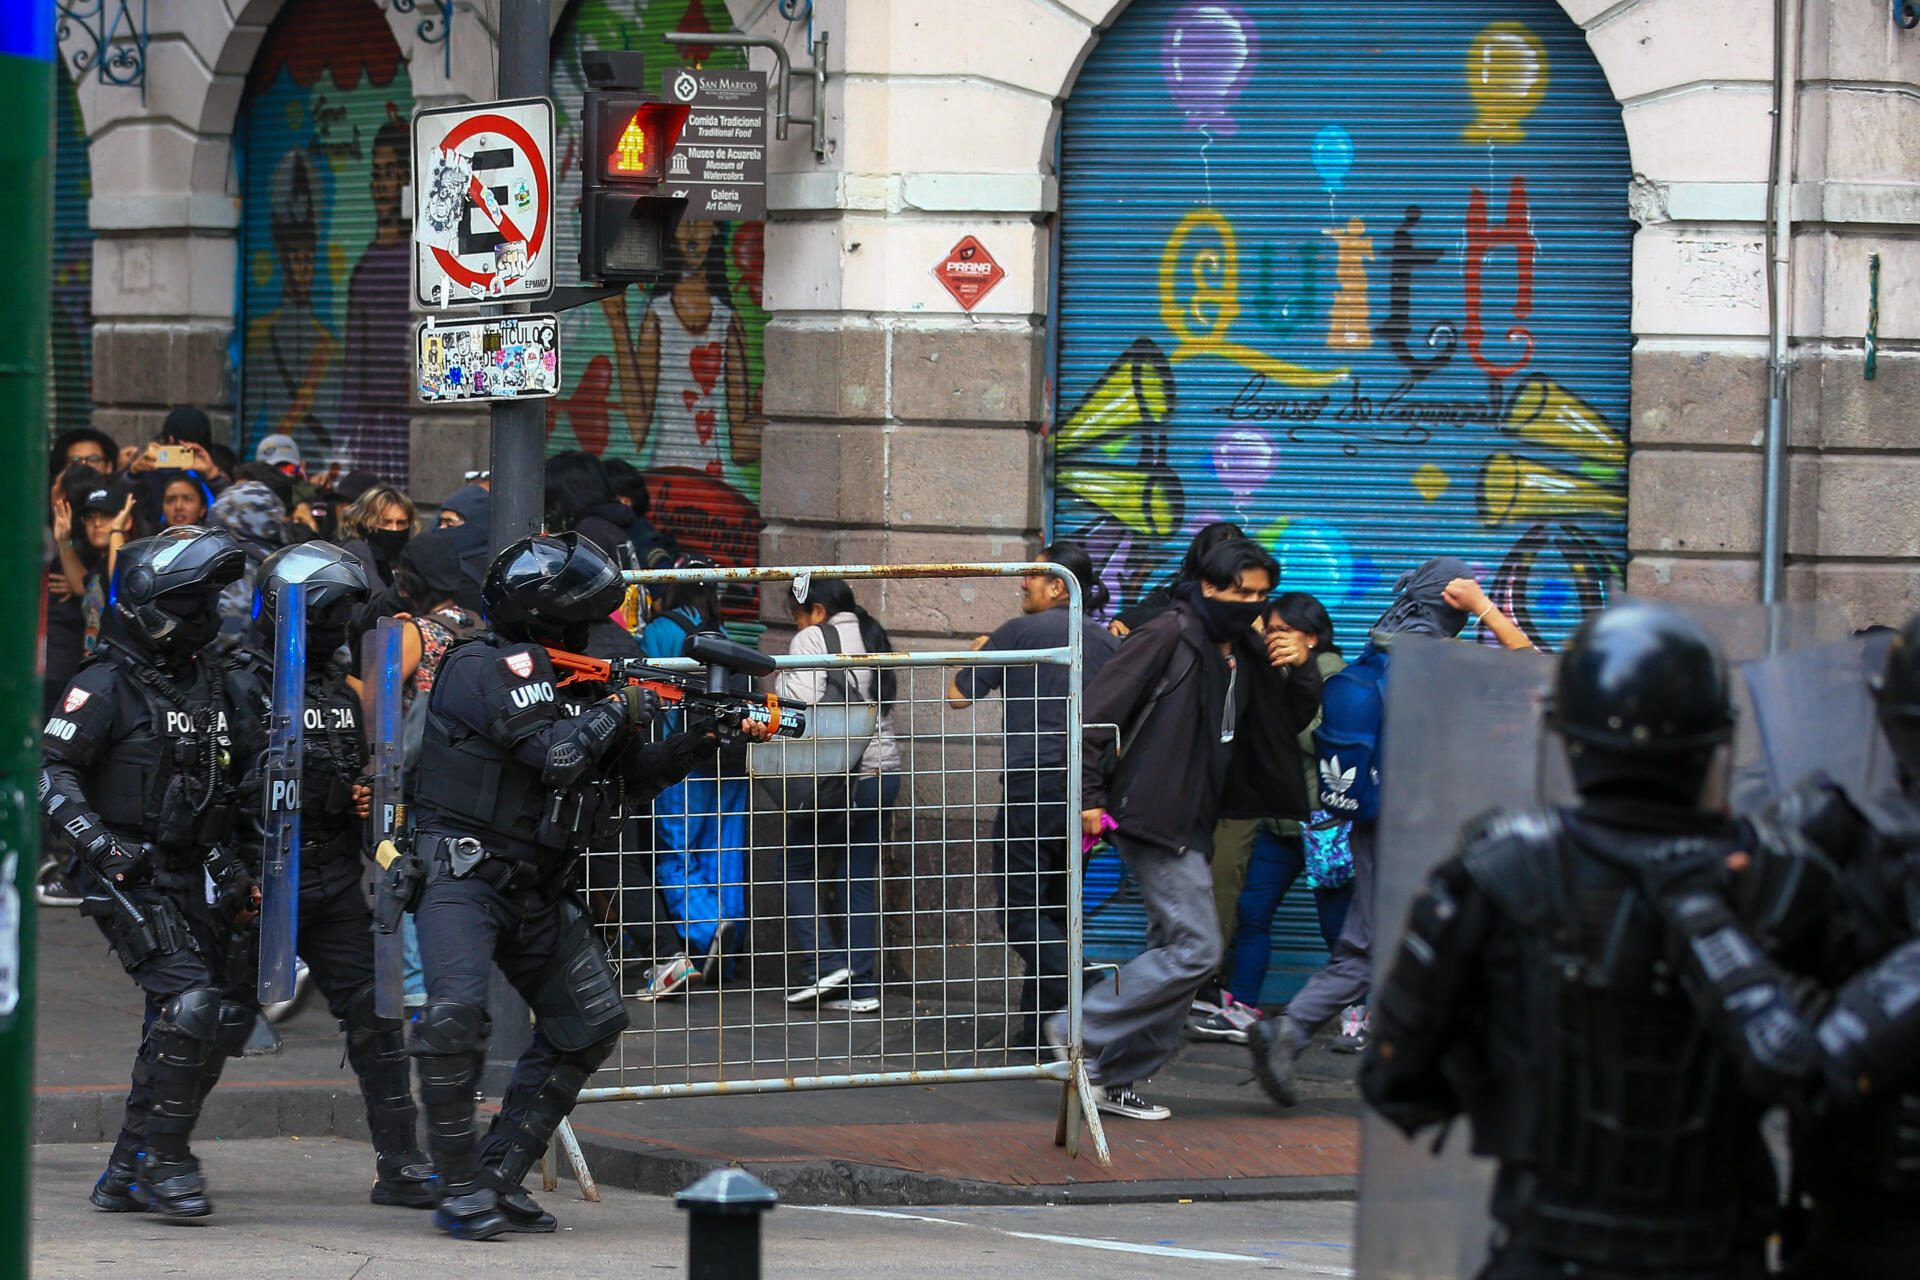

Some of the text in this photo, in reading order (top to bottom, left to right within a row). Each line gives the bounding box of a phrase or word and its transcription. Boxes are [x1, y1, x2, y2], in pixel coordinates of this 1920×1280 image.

[699, 77, 758, 90] SAN MARCOS
[689, 115, 761, 127] Comida Tradicional
[698, 127, 752, 138] Traditional Food
[688, 148, 761, 160] Museo de Acuarela
[706, 160, 744, 170] Museum of
[703, 171, 744, 181] Watercolors
[711, 189, 739, 200] Galeria
[705, 202, 742, 213] Art Gallery
[525, 279, 548, 289] EPMMOP
[509, 681, 555, 708] UMO
